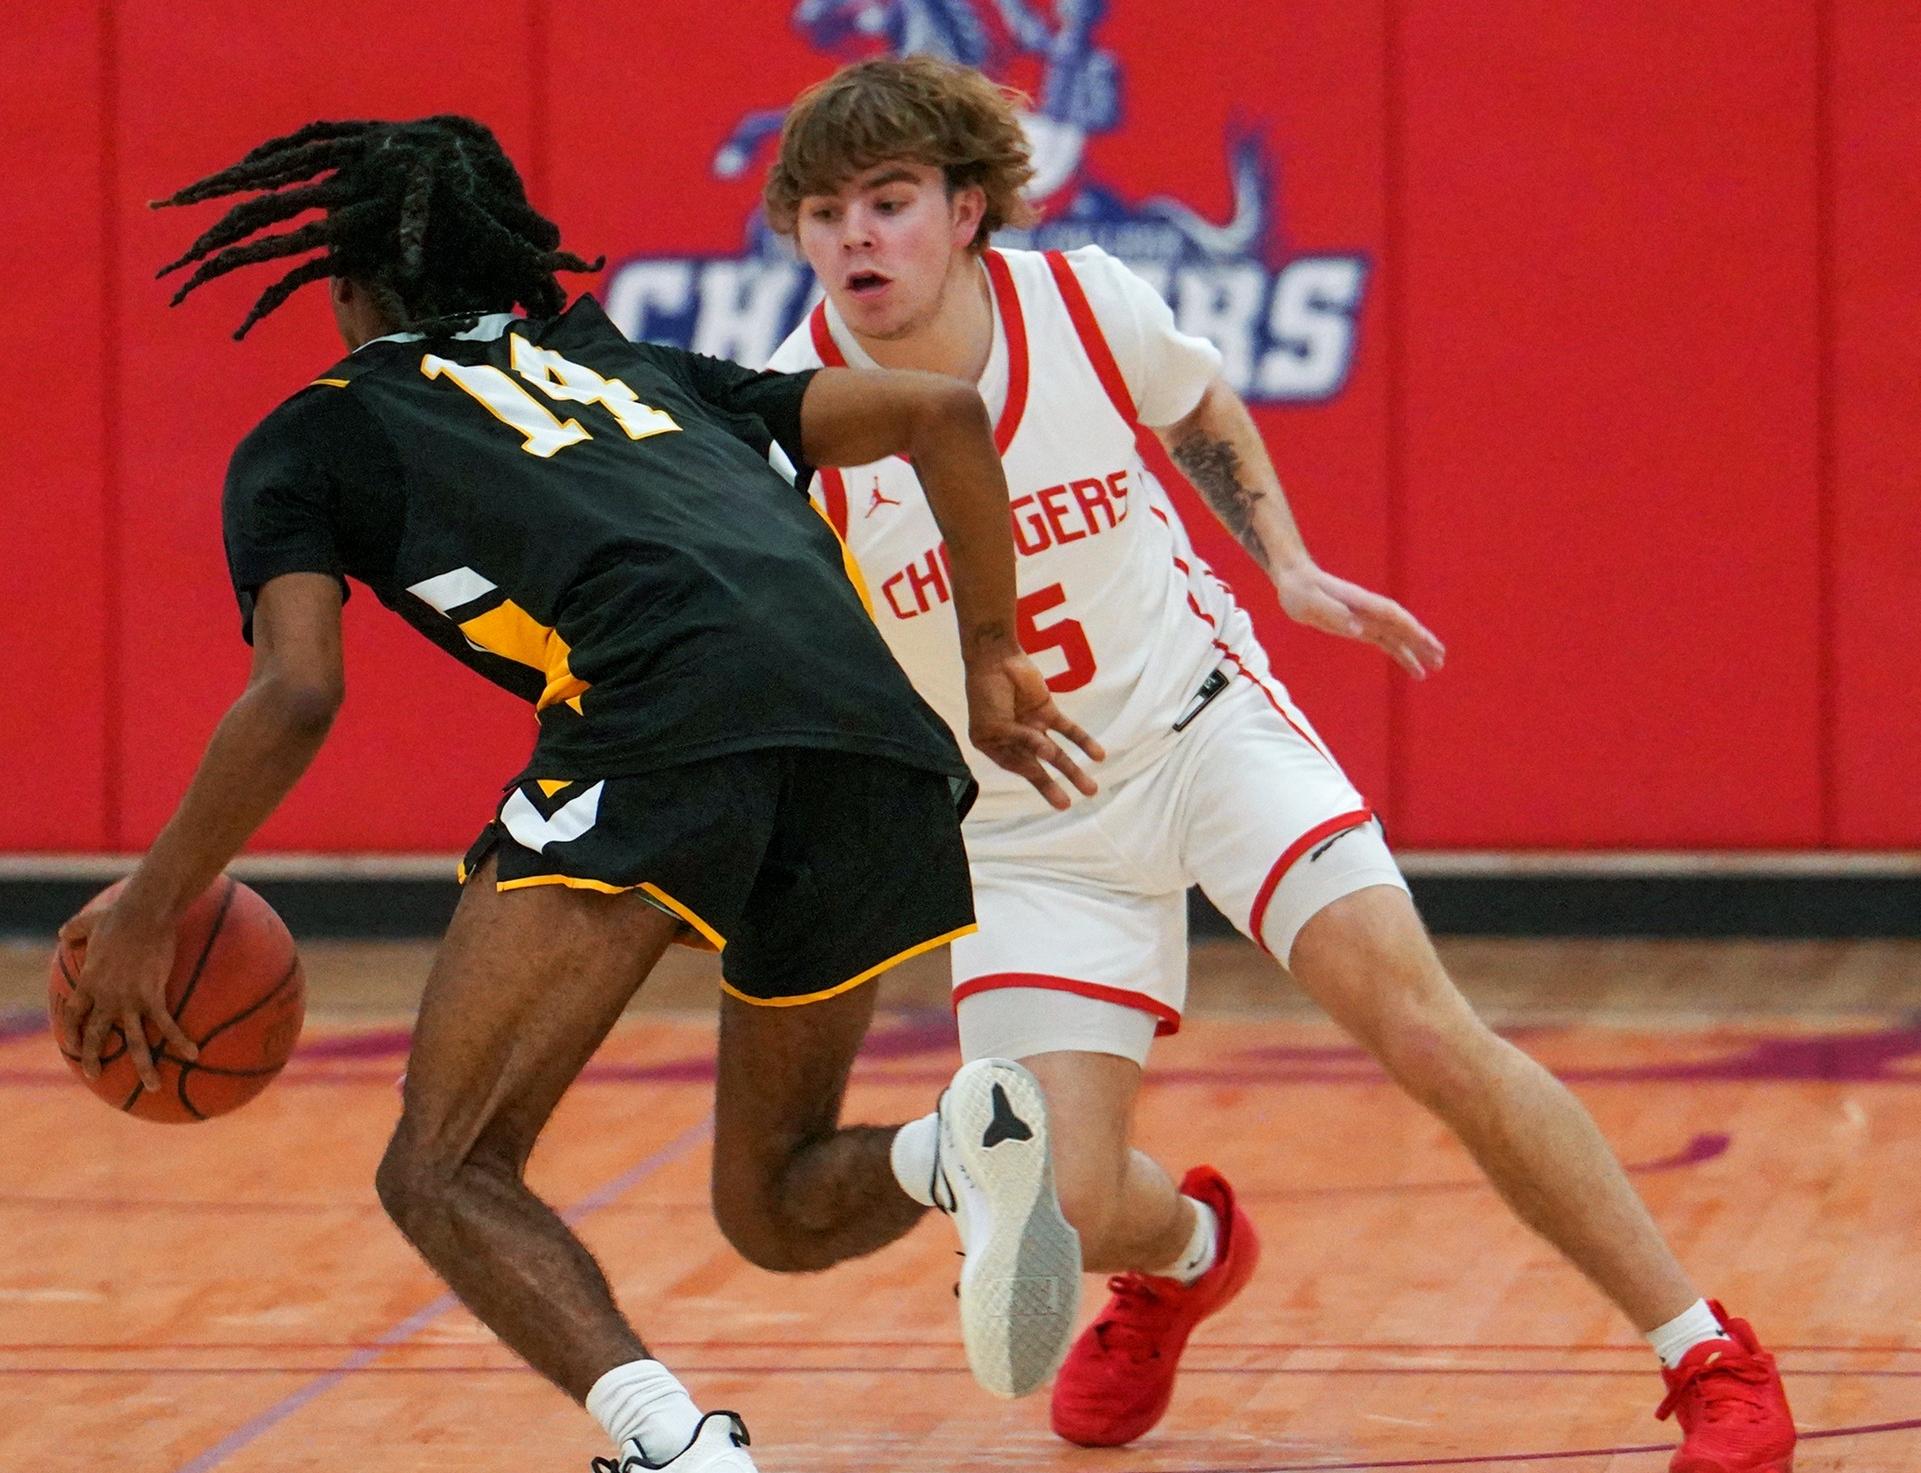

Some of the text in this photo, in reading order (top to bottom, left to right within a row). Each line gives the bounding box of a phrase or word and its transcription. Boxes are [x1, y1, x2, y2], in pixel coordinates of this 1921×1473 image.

[605, 256, 1362, 395] CHRS
[420, 332, 683, 458] 14
[881, 470, 1128, 619] CHGERS
[1016, 583, 1097, 694] 5
